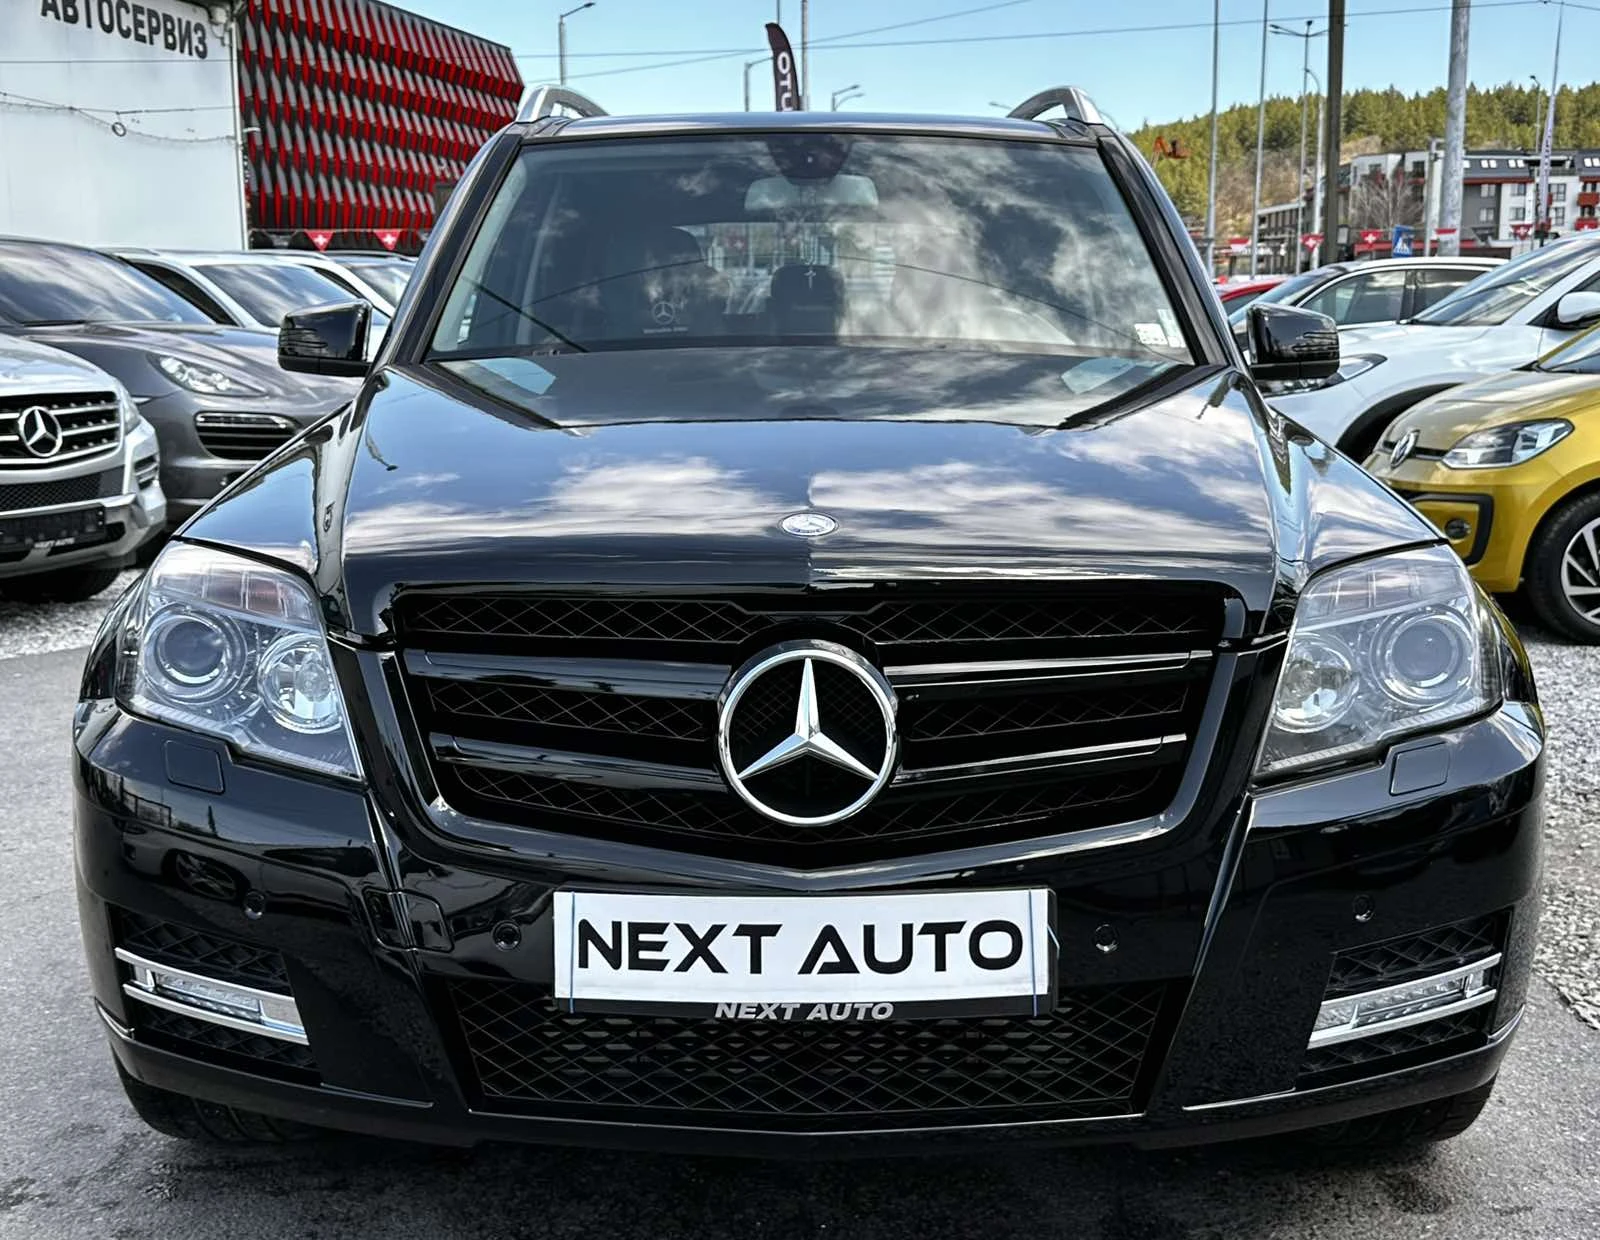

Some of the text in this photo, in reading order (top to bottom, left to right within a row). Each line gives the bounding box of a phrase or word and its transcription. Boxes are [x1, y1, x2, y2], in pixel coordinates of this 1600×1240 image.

[578, 918, 1023, 974] NEXT AUTO
[715, 1002, 894, 1021] NEXT AUTO
